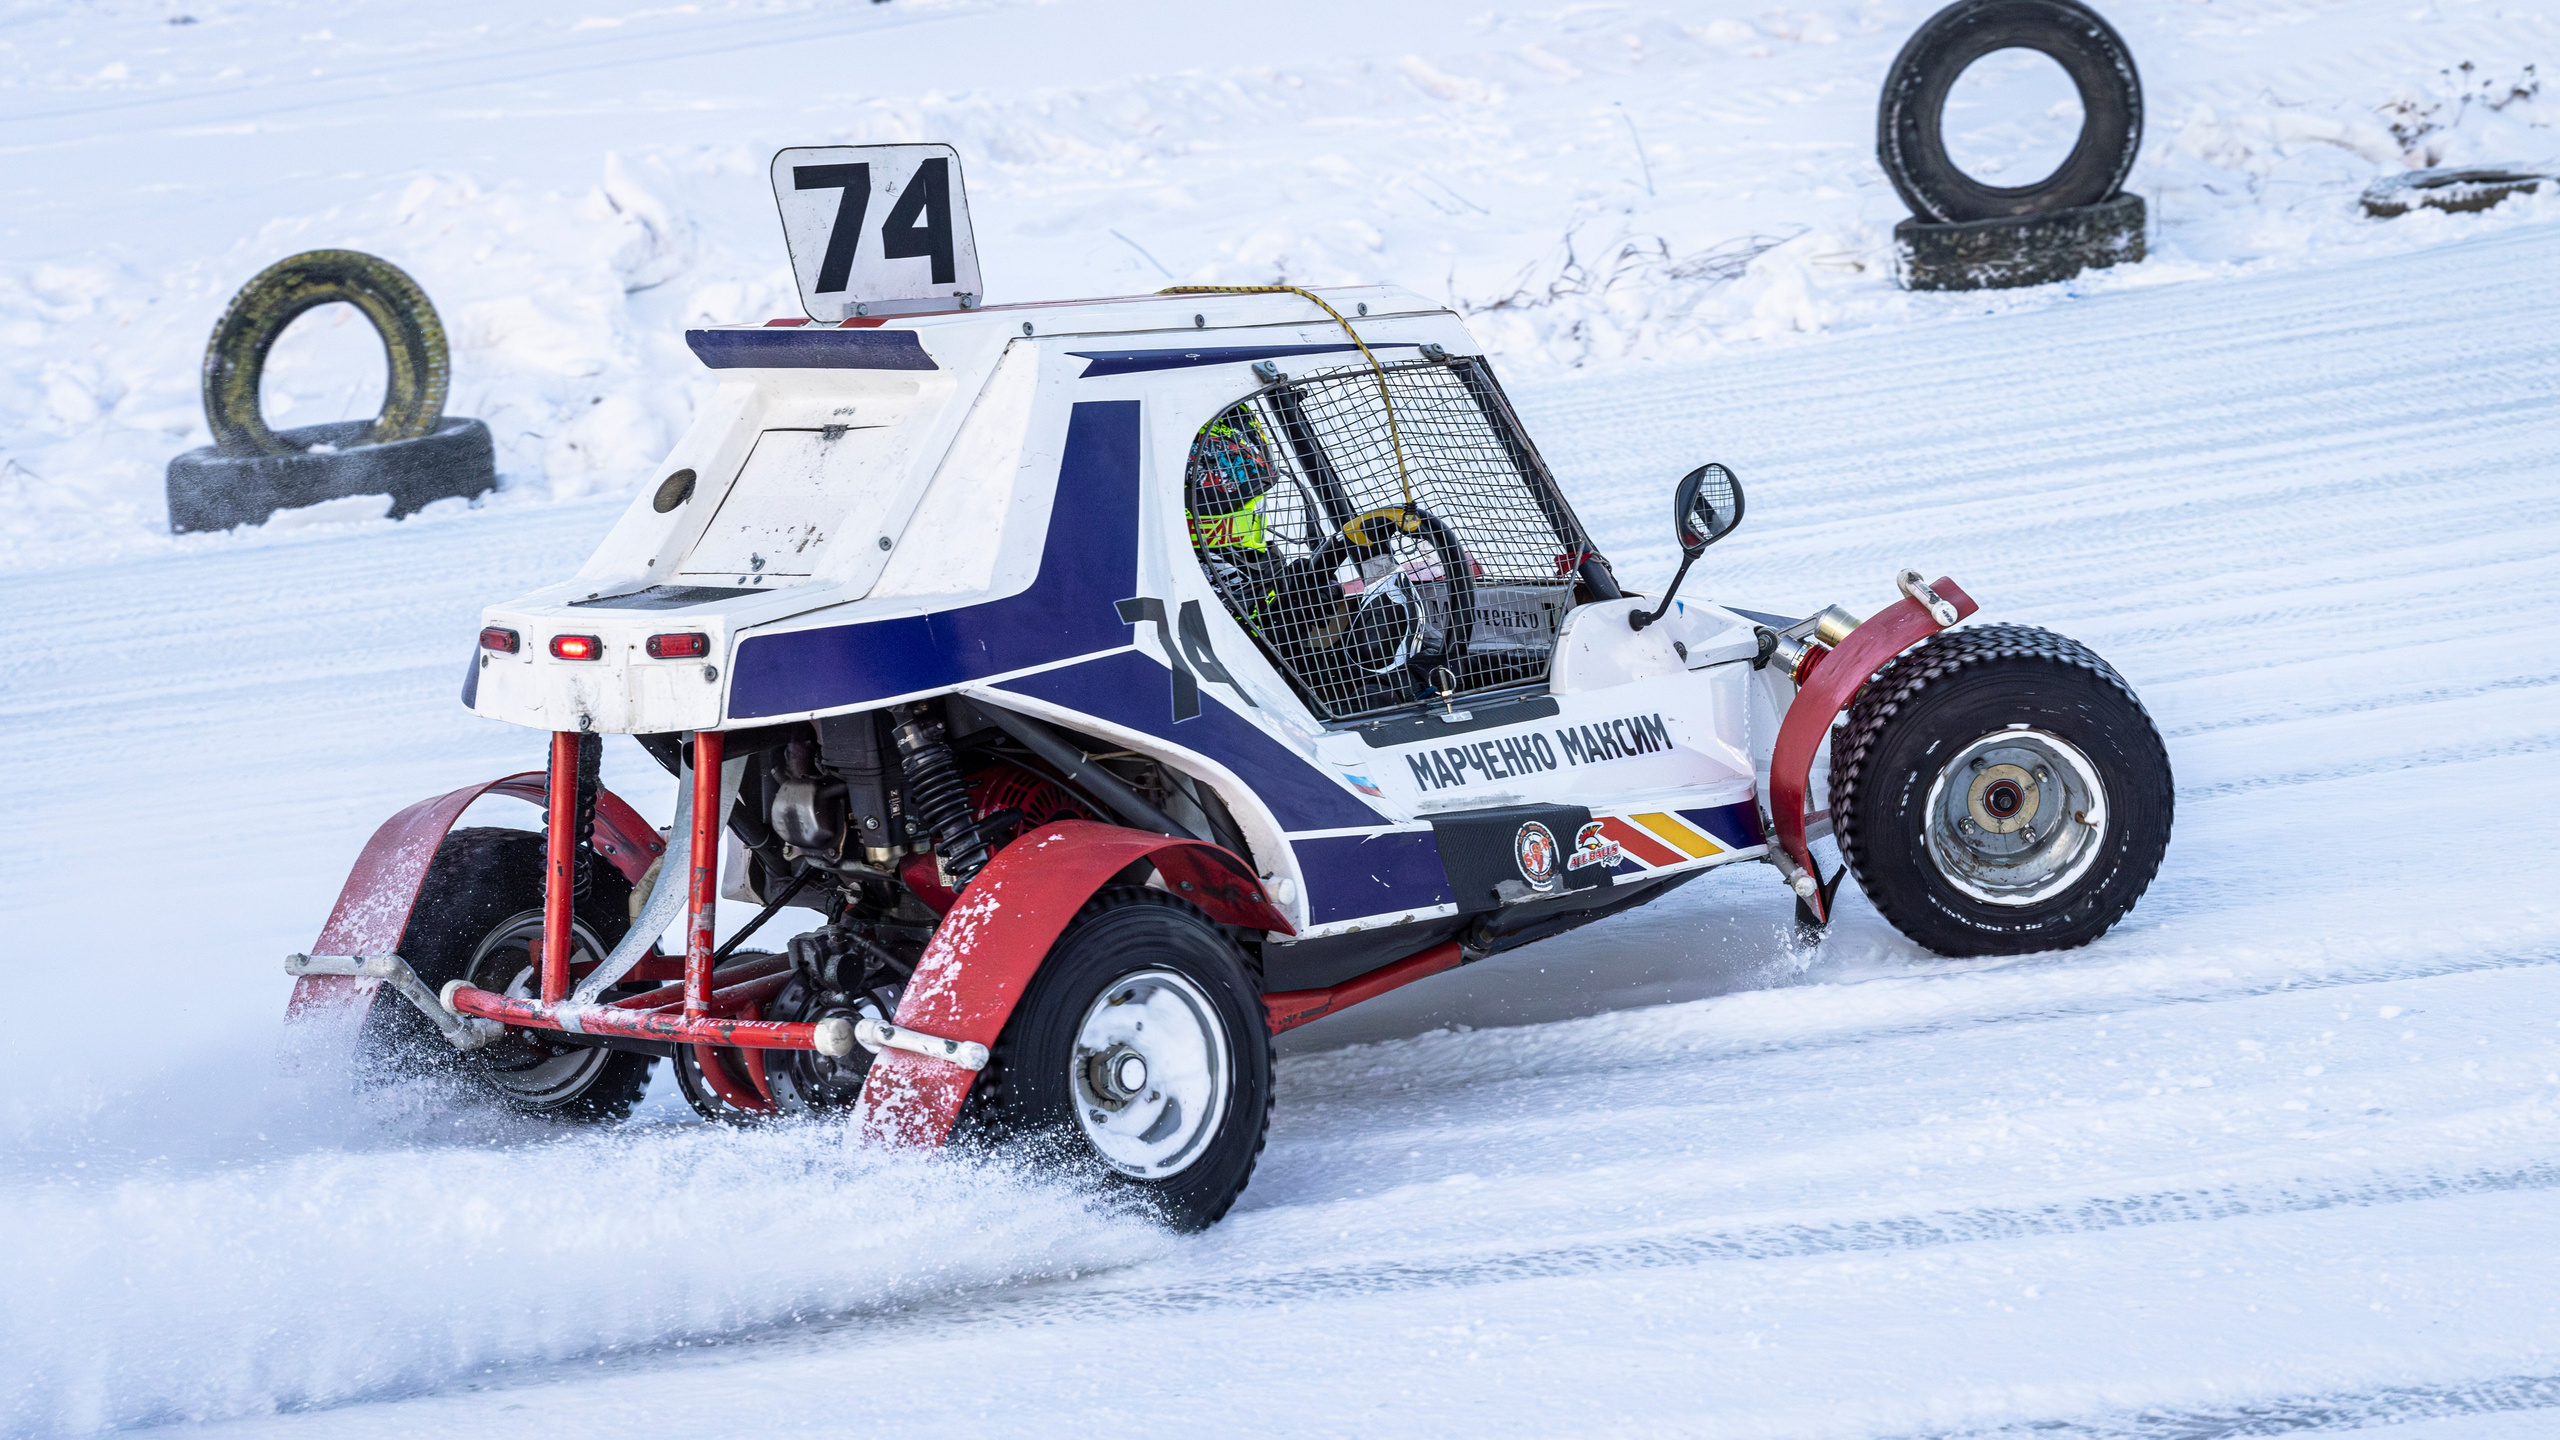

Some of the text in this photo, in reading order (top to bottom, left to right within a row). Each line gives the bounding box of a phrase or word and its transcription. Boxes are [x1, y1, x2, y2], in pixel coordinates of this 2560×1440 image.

[793, 157, 956, 294] 74
[1113, 597, 1260, 724] 74
[1405, 713, 1673, 791] МАРЧЕНКО МАКСИМ
[1571, 843, 1618, 868] ALL BALLS
